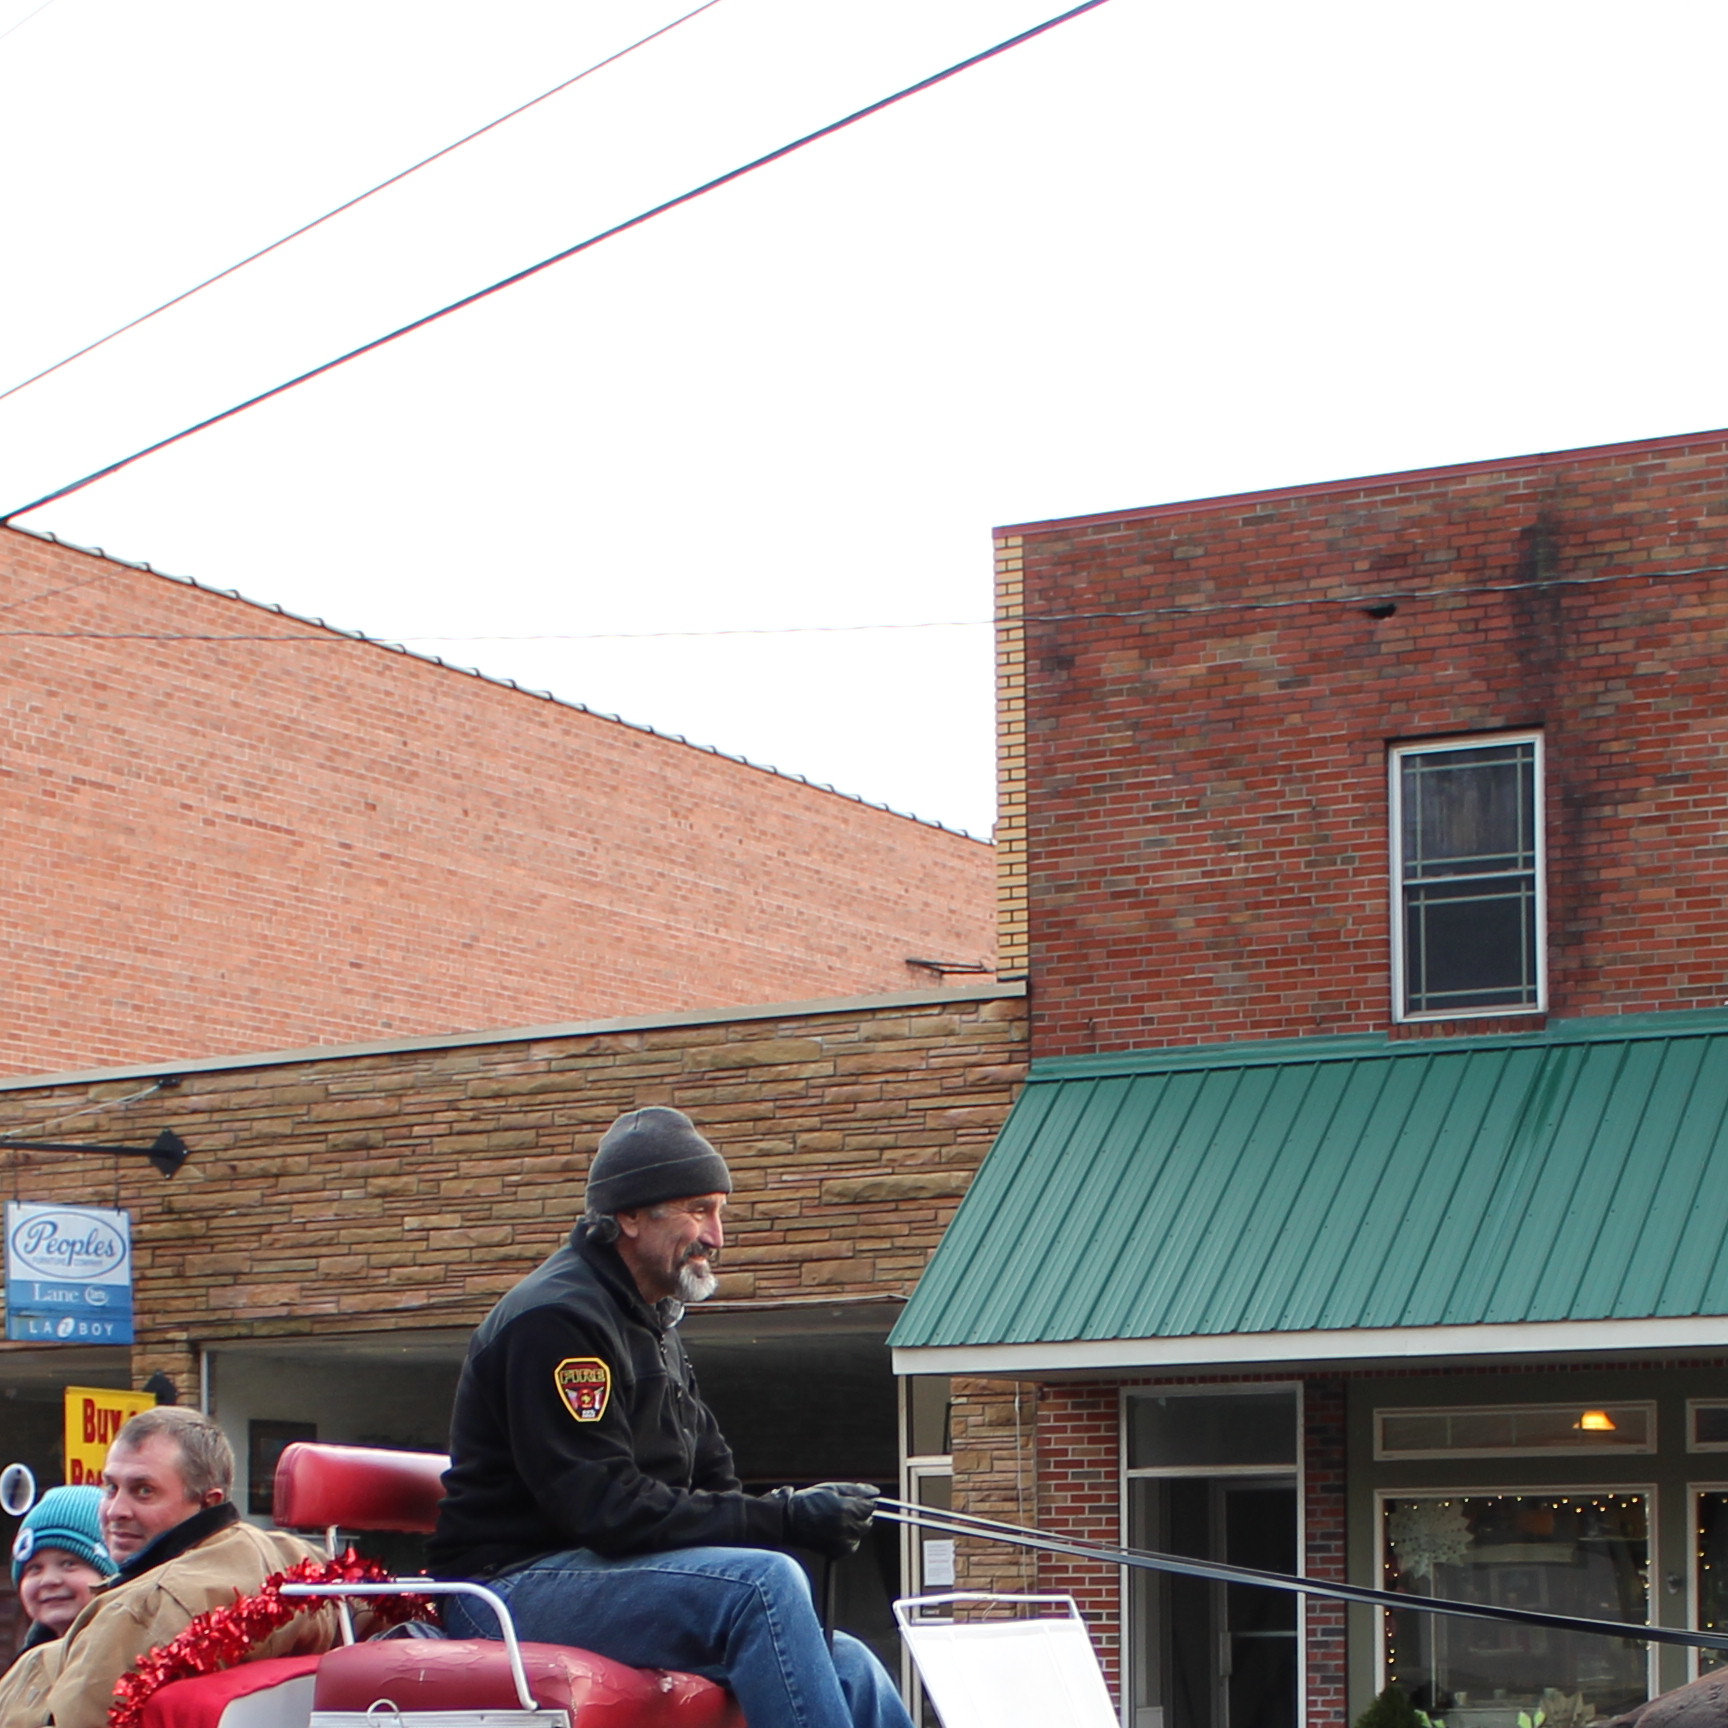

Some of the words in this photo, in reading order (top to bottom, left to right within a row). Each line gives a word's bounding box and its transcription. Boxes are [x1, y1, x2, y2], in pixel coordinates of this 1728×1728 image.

[23, 1220, 115, 1267] Peoples
[33, 1283, 80, 1303] Lane
[559, 1368, 606, 1384] FIRE
